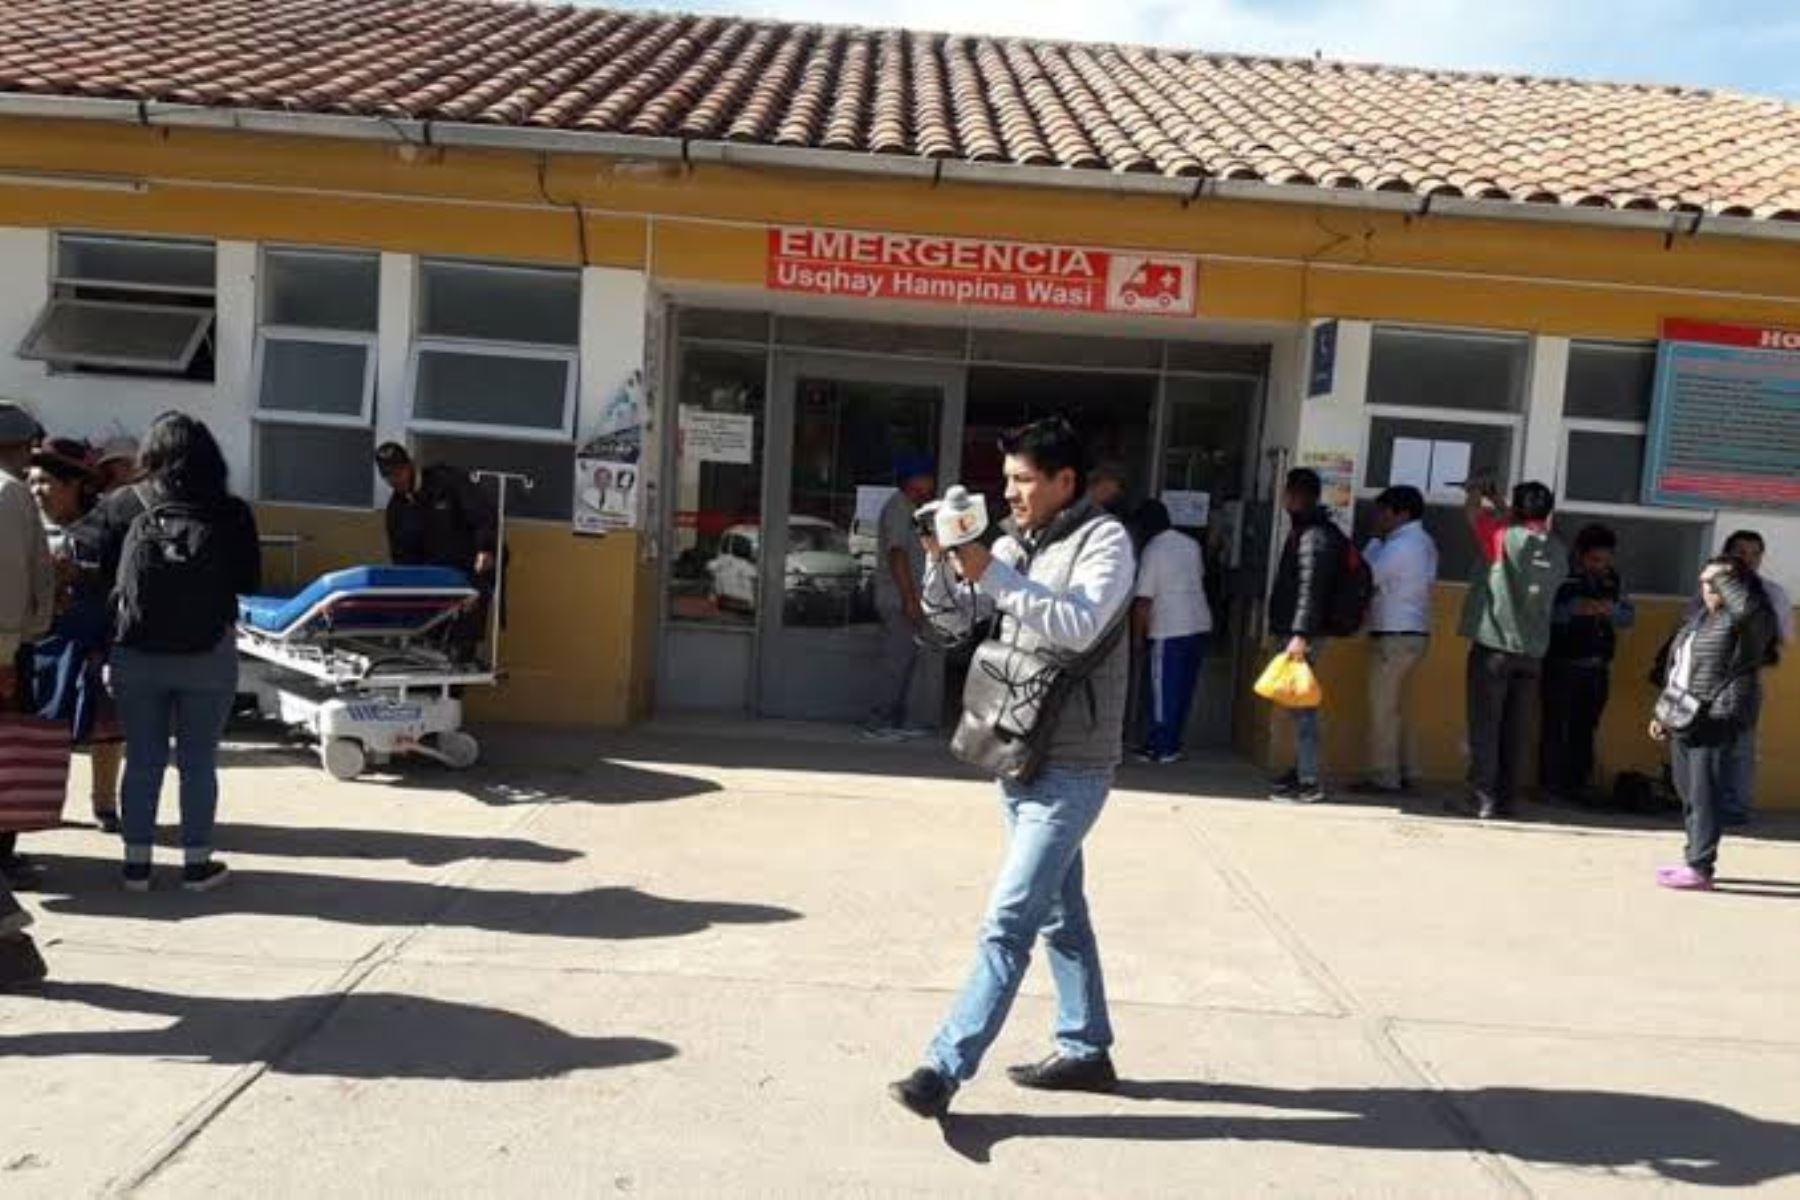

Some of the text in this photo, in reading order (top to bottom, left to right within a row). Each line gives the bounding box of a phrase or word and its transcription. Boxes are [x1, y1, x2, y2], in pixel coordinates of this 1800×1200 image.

[780, 229, 1094, 276] EMERGENCIA
[779, 263, 1092, 305] Usqhay Hampina Wasi
